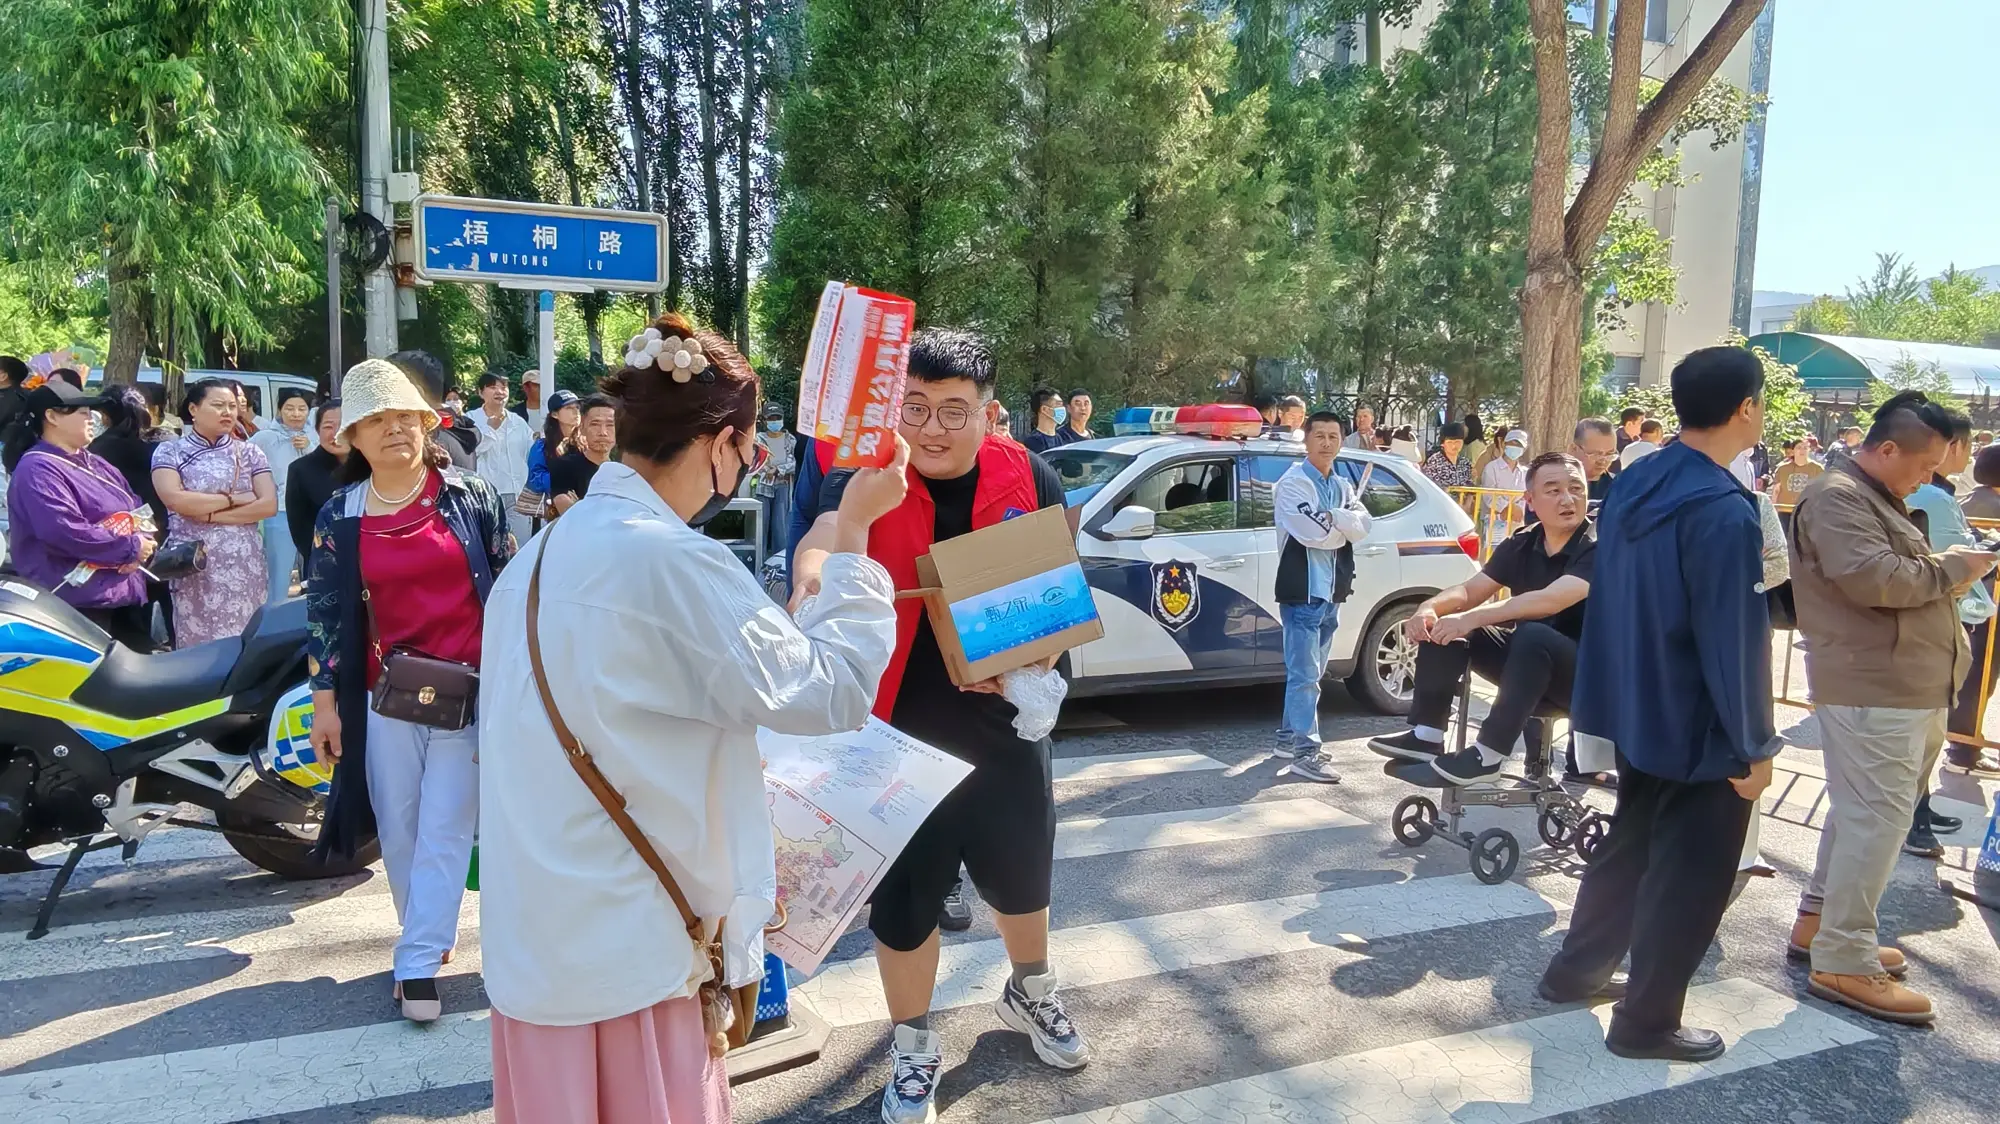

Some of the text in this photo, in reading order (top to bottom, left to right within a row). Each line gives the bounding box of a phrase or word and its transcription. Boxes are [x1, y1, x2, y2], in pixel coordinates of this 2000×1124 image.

[463, 219, 622, 255] 梧桐路
[490, 252, 603, 271] WUTONG LU
